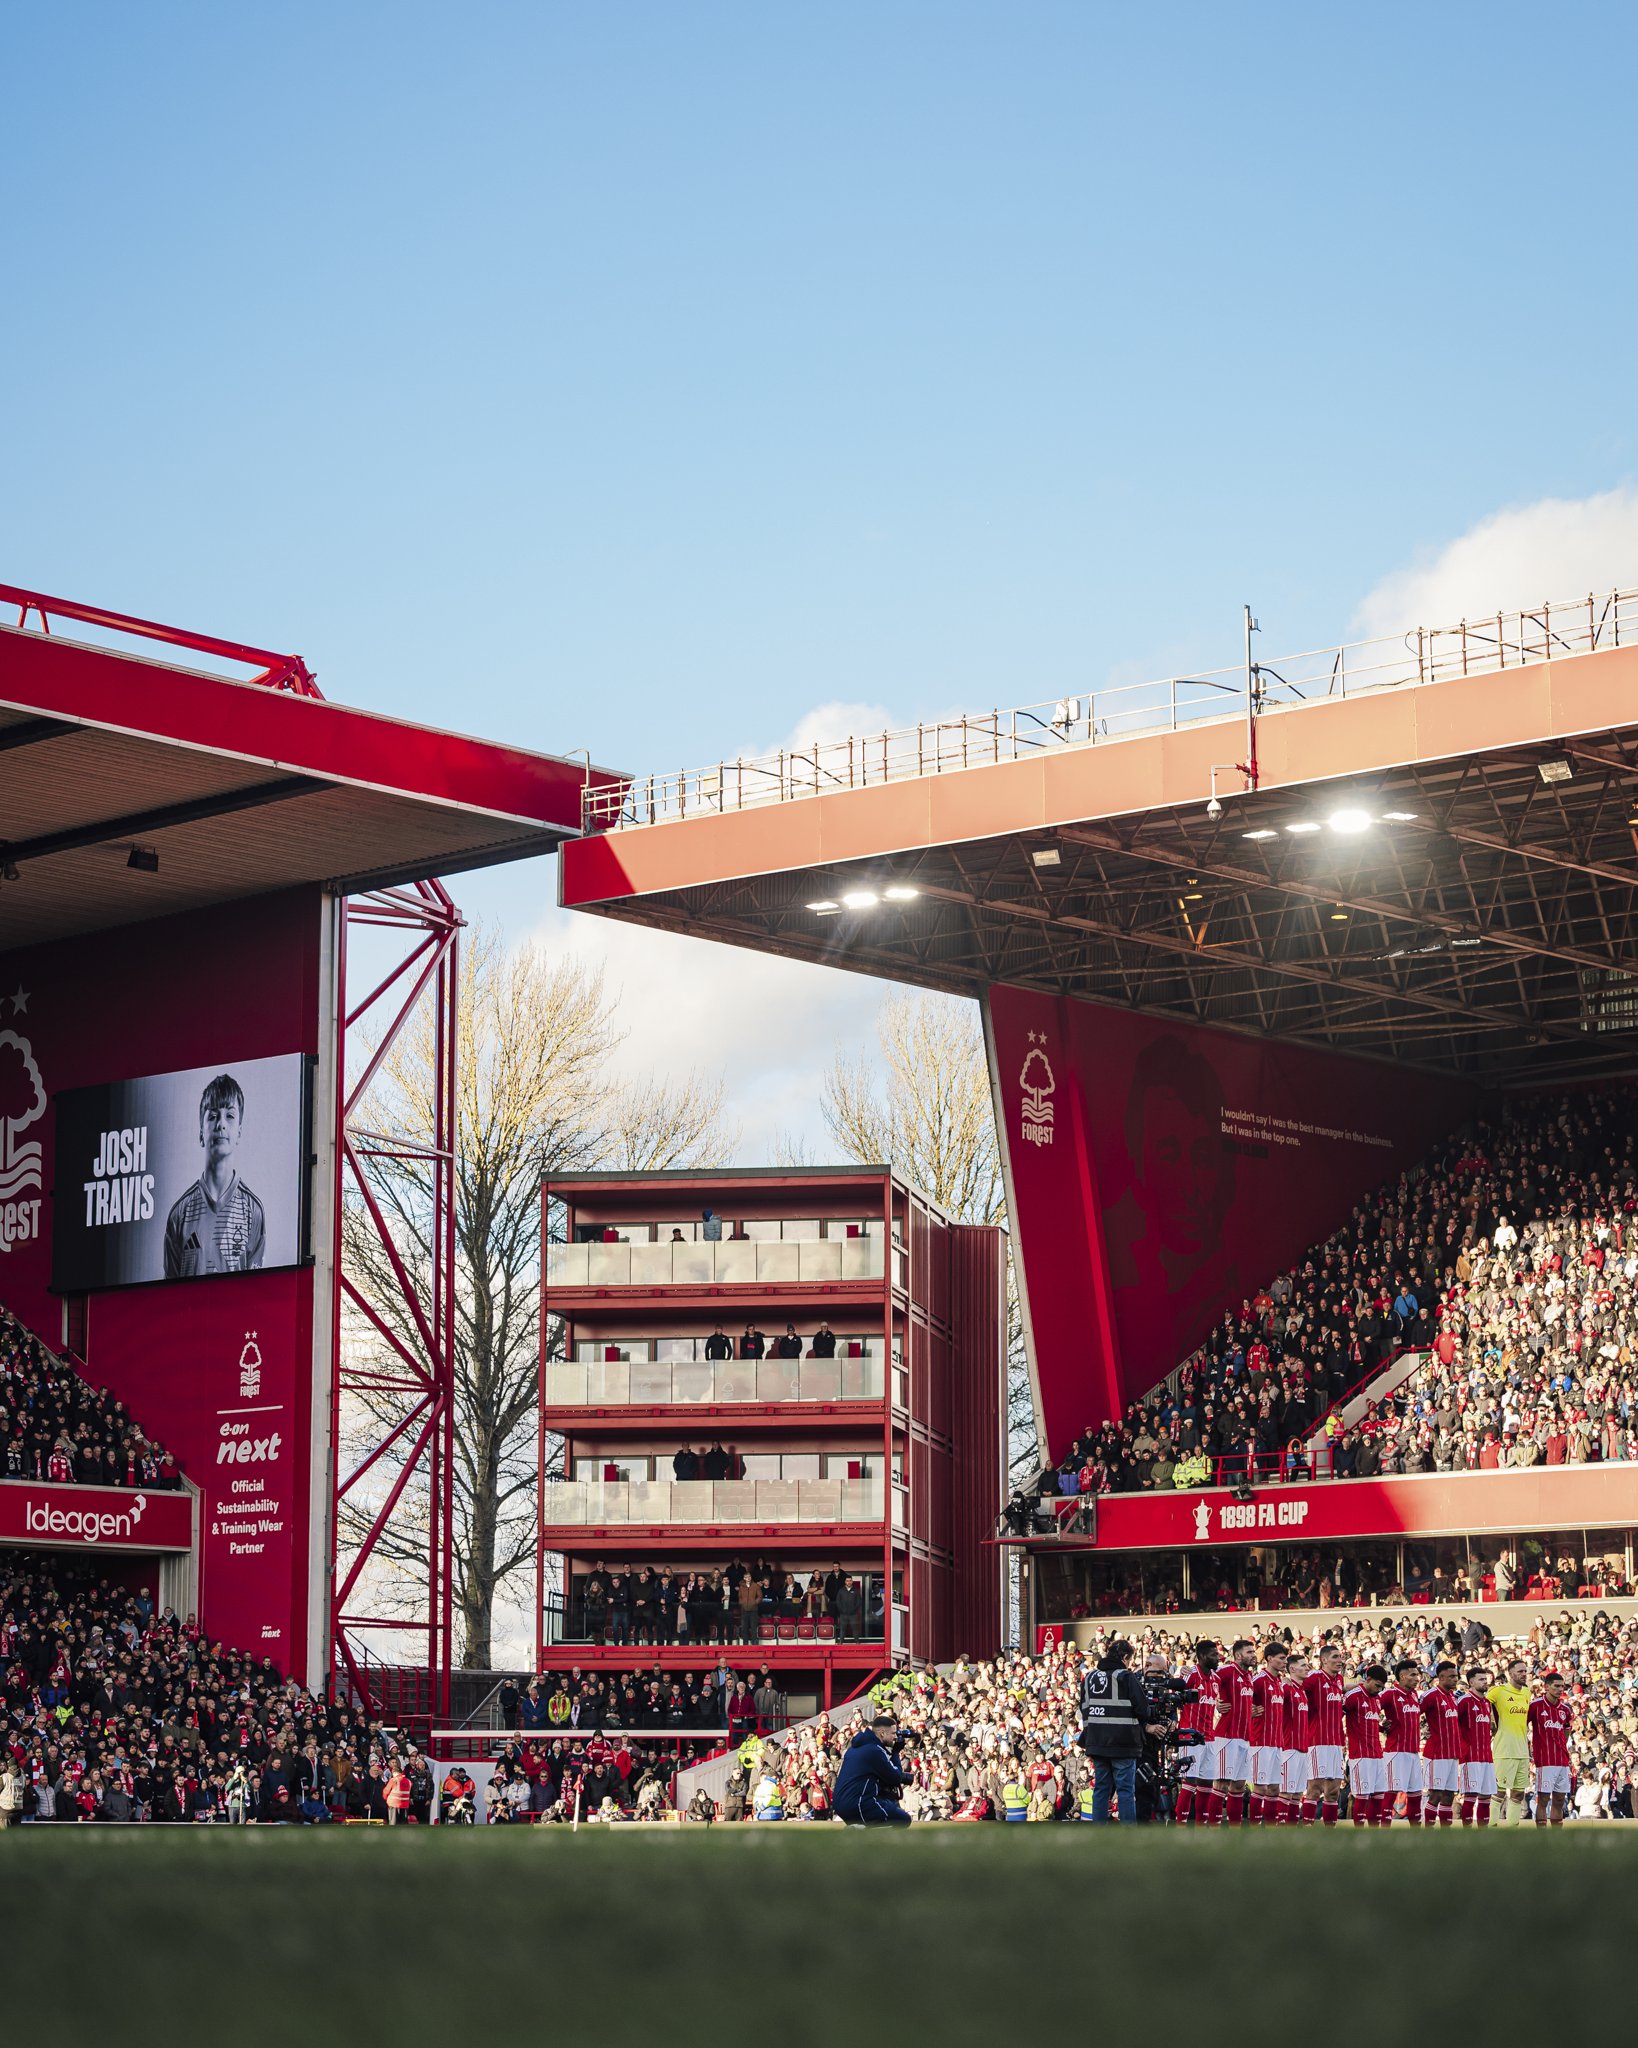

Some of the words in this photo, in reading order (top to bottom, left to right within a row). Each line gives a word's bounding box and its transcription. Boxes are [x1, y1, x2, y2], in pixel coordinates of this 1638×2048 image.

[1221, 1122, 1234, 1134] But
[1238, 1128, 1252, 1137] was
[1253, 1127, 1260, 1139] in
[1261, 1129, 1272, 1140] the
[1273, 1132, 1285, 1145] top
[1285, 1136, 1301, 1146] one.
[1225, 1109, 1255, 1122] wouldn't
[1256, 1115, 1268, 1126] say
[1273, 1118, 1287, 1128] was
[1287, 1119, 1299, 1131] the
[1299, 1121, 1314, 1133] best
[1315, 1126, 1345, 1139] manager
[1345, 1129, 1352, 1140] in
[1352, 1131, 1364, 1142] the
[93, 1126, 147, 1178] JOSH
[83, 1174, 155, 1227] TRAVIS
[216, 1432, 282, 1465] next
[231, 1478, 265, 1493] Official
[216, 1499, 279, 1515] Sustainability
[1220, 1505, 1256, 1529] 1898
[1258, 1503, 1276, 1527] FA
[1278, 1501, 1308, 1526] CUP
[26, 1501, 131, 1542] Ideagen
[211, 1522, 220, 1535] &
[220, 1520, 257, 1536] Training
[257, 1519, 284, 1533] Wear
[229, 1542, 265, 1555] Partner
[261, 1629, 281, 1638] next
[1089, 1706, 1105, 1716] 202
